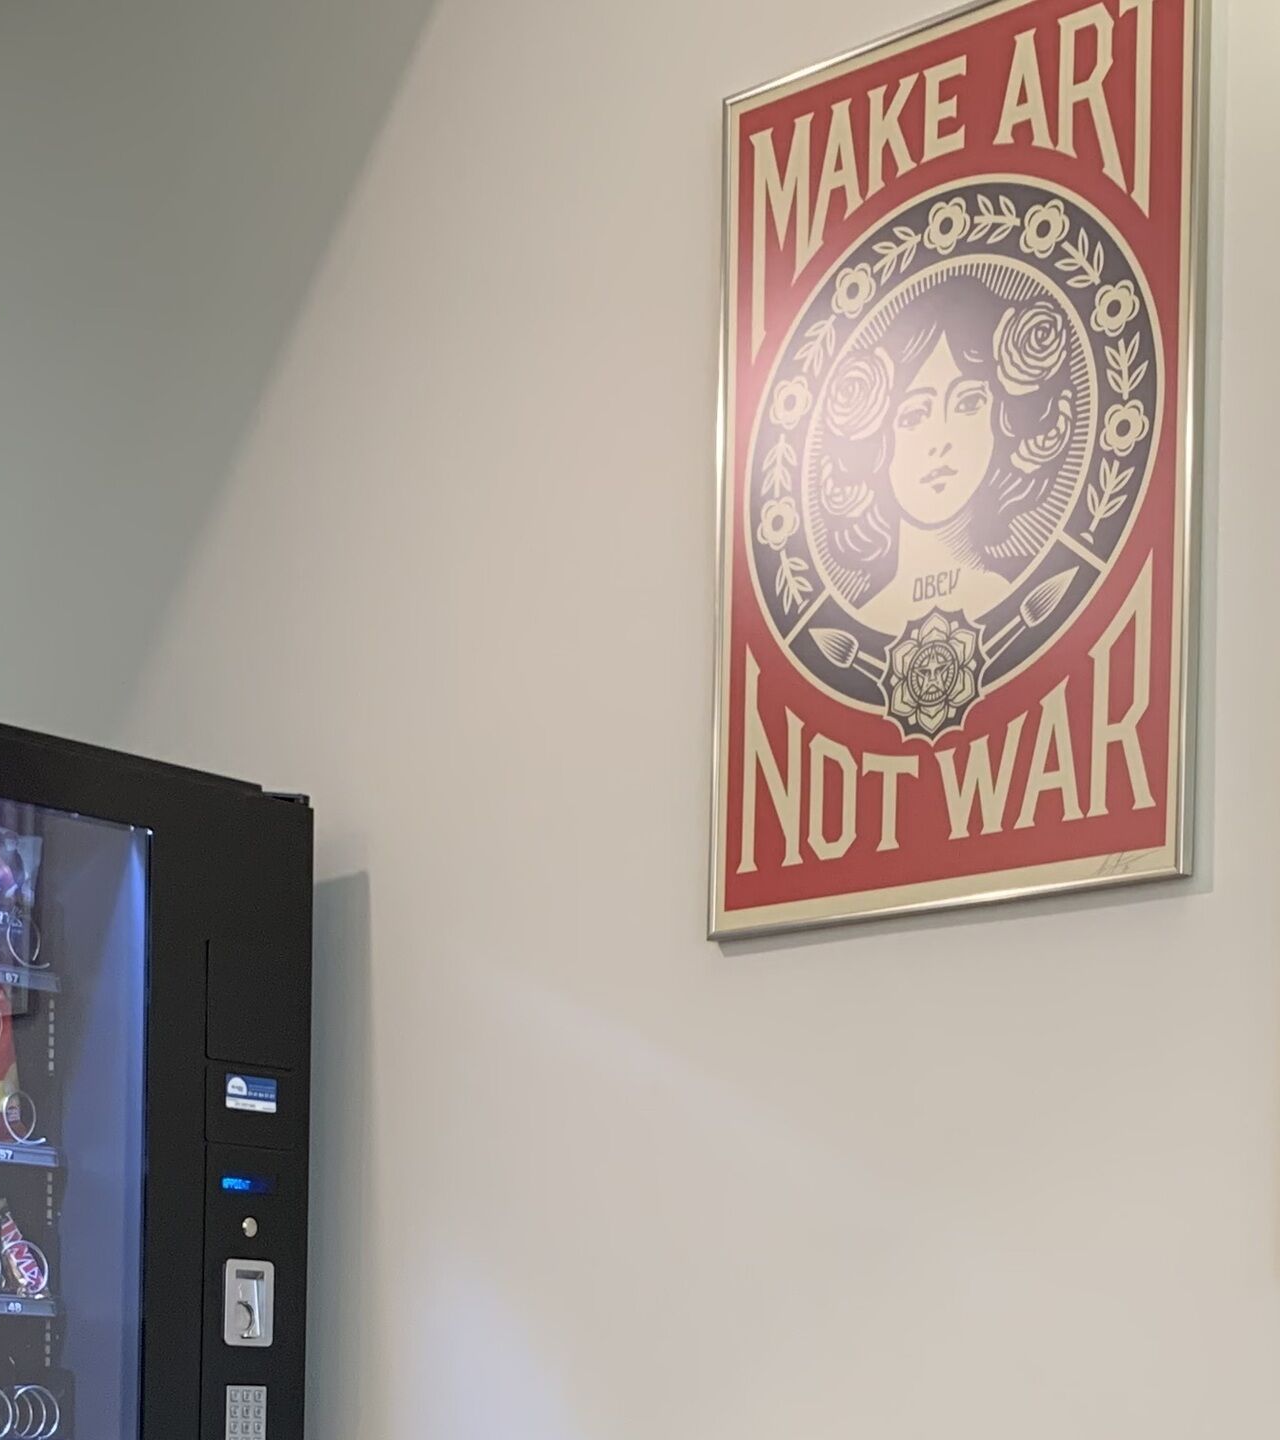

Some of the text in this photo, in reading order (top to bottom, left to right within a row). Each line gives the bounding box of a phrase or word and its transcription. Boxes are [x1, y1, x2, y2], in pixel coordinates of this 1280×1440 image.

[749, 0, 1153, 362] MAKE ART
[912, 568, 961, 603] OBEY
[736, 548, 1157, 875] NOT WAR
[0, 1149, 13, 1160] 57
